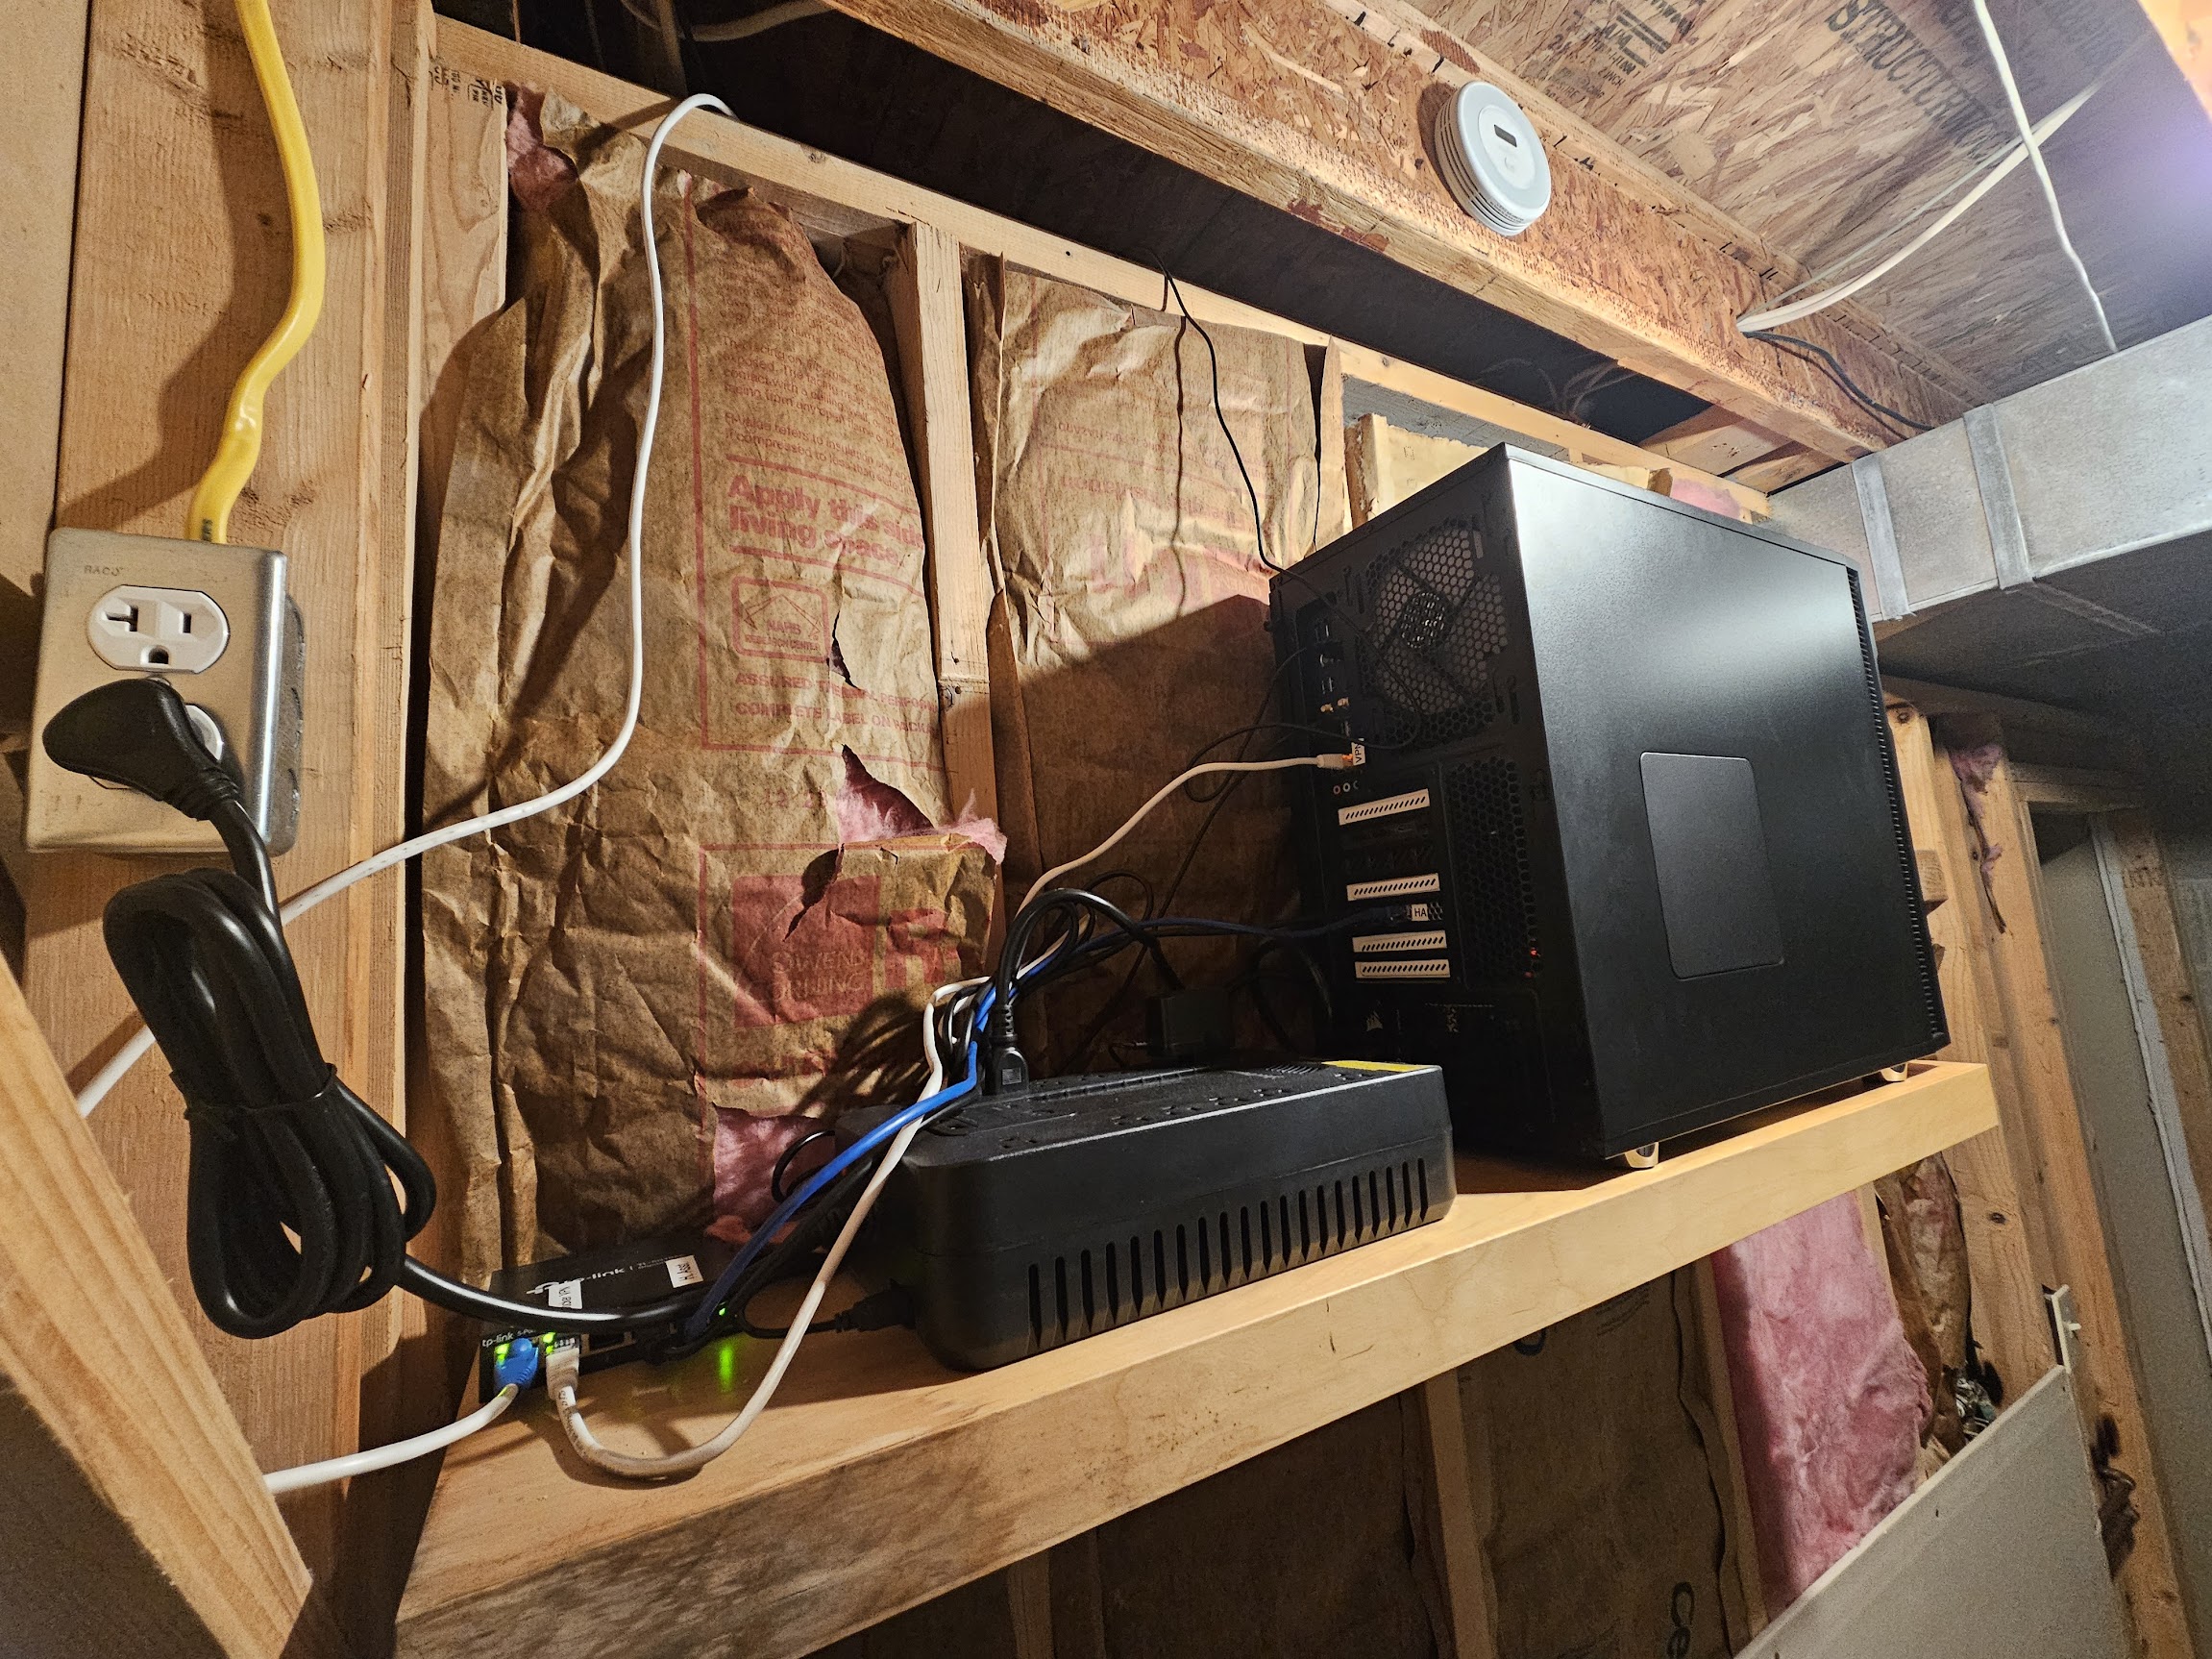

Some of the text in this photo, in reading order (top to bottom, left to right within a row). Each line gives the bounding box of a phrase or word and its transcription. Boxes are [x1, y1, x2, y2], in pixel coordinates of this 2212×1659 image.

[727, 474, 821, 520] Apply
[827, 498, 878, 532] this
[728, 505, 818, 550] living
[84, 564, 120, 577] RACO
[735, 672, 813, 689] ASSURED
[735, 701, 823, 720] COMPLETE
[826, 708, 869, 726] LABEL
[872, 714, 892, 729] ON
[1413, 906, 1427, 917] HA
[772, 951, 867, 973] OWENS
[481, 1331, 514, 1349] tp-link
